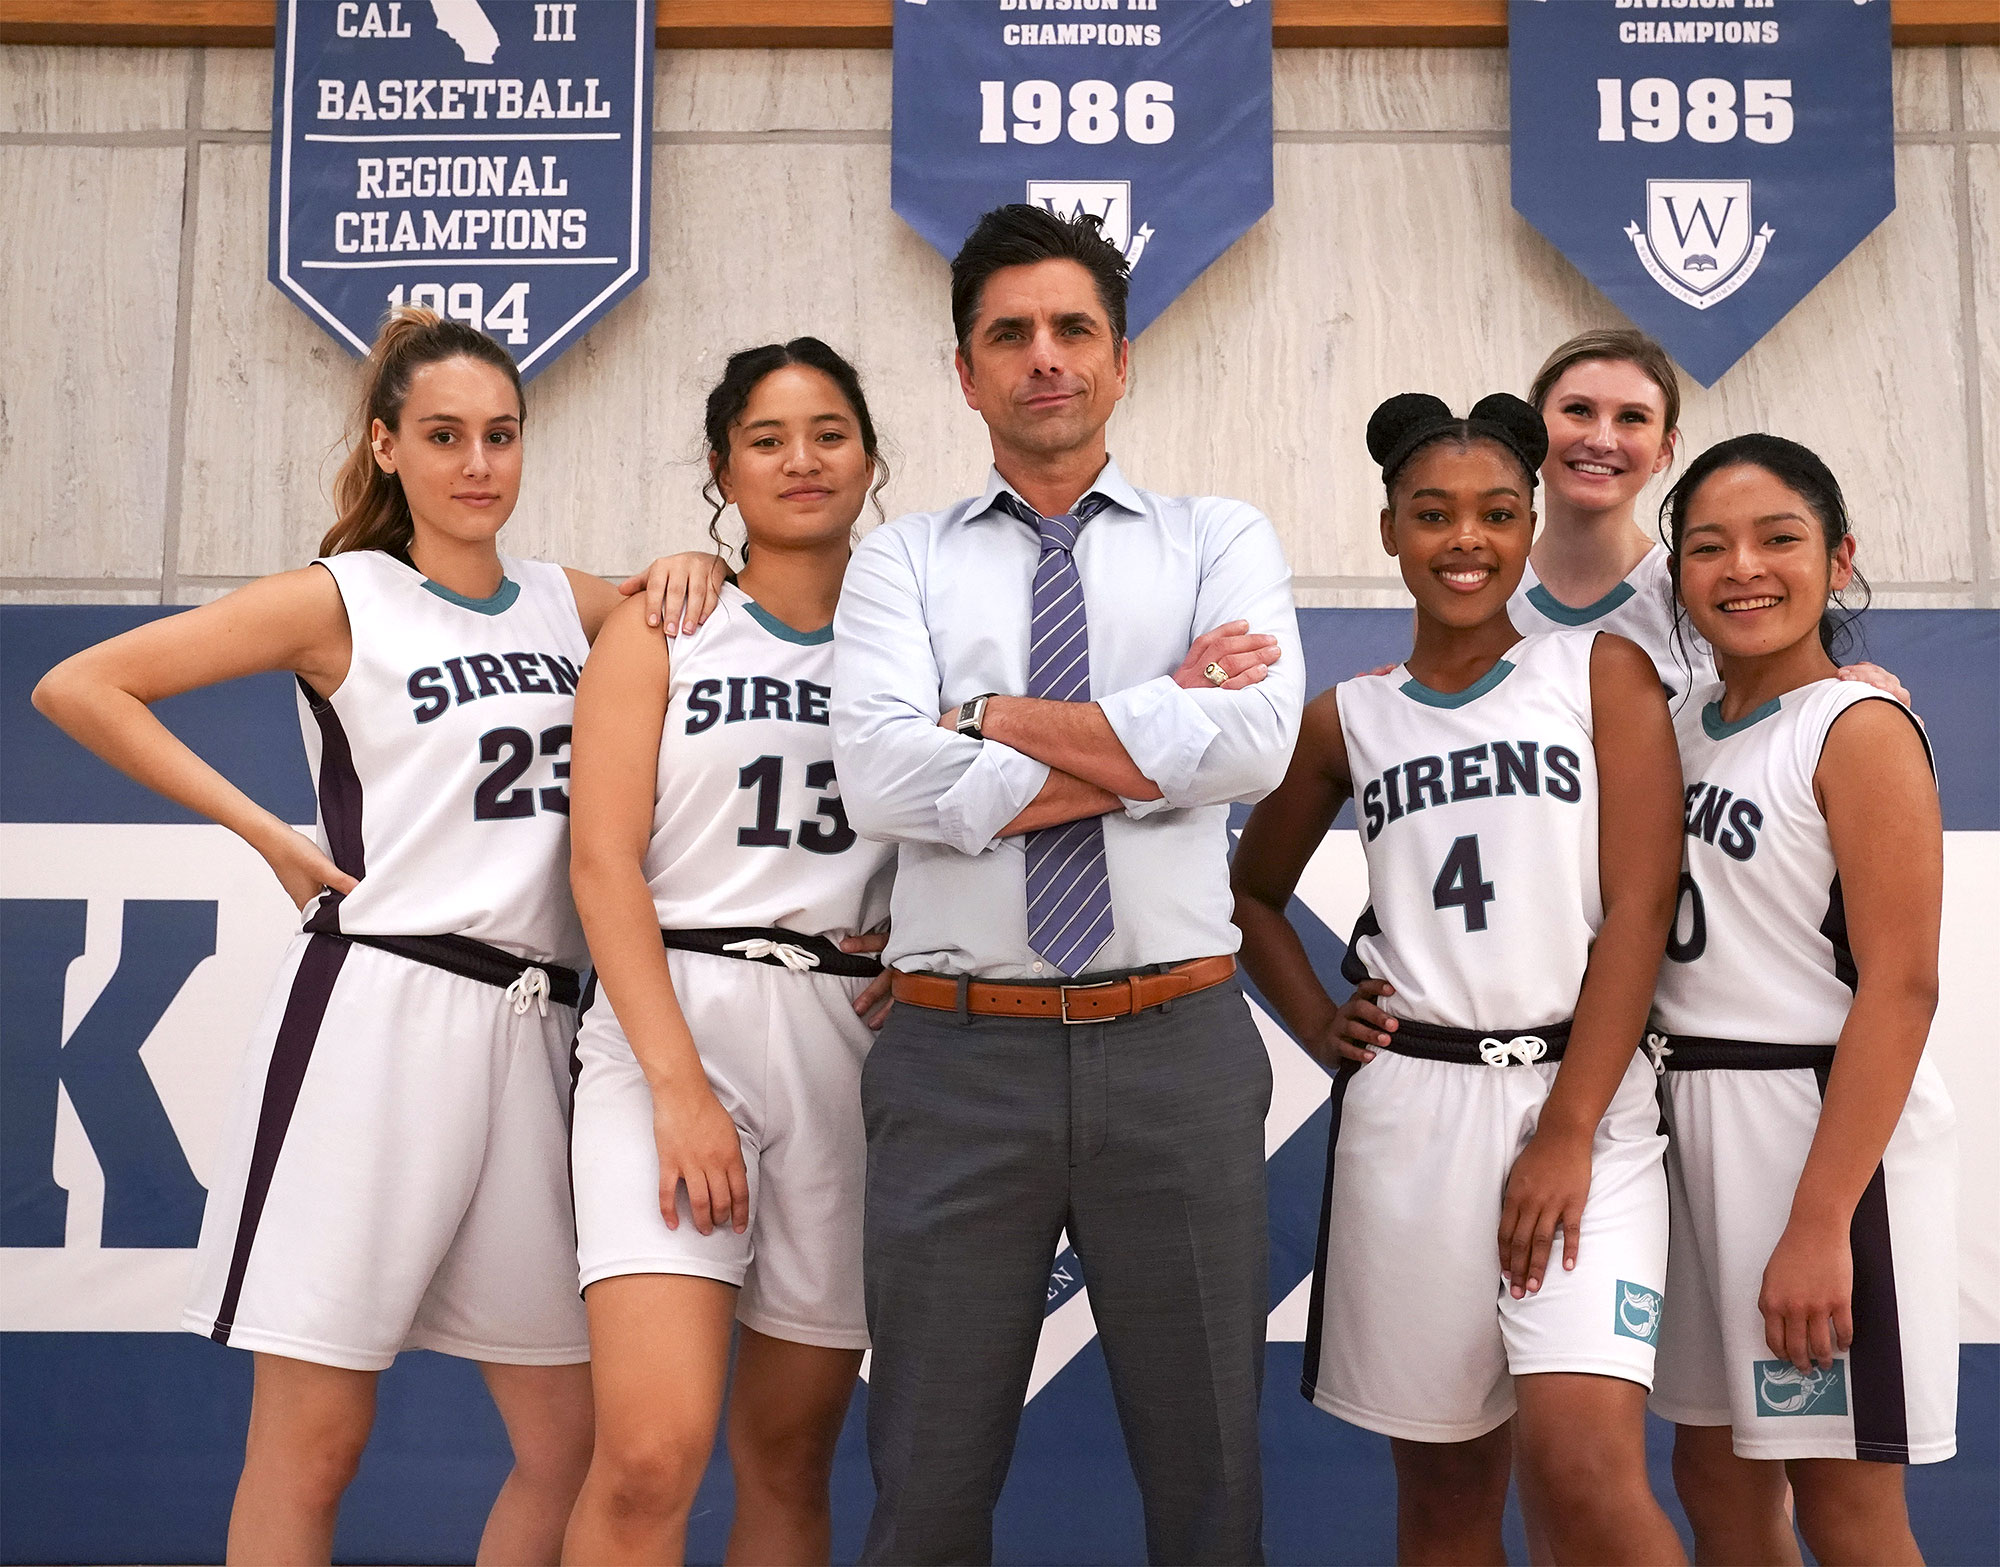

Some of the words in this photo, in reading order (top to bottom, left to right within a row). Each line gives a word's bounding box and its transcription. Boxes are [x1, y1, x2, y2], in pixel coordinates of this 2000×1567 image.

[336, 2, 411, 38] CAL
[533, 3, 577, 41] III
[1003, 24, 1161, 46] CHAMPIONS
[1619, 21, 1779, 43] CHAMPIONS
[317, 79, 611, 120] BASKETBALL
[979, 79, 1175, 145] 1986
[1597, 77, 1794, 144] 1985
[356, 156, 568, 199] REGIONAL
[335, 209, 587, 253] CHAMPIONS
[1658, 196, 1739, 249] W
[407, 652, 583, 724] SIREN
[737, 754, 857, 855] 13
[1363, 740, 1582, 843] SIRENS
[1432, 833, 1495, 933] 4
